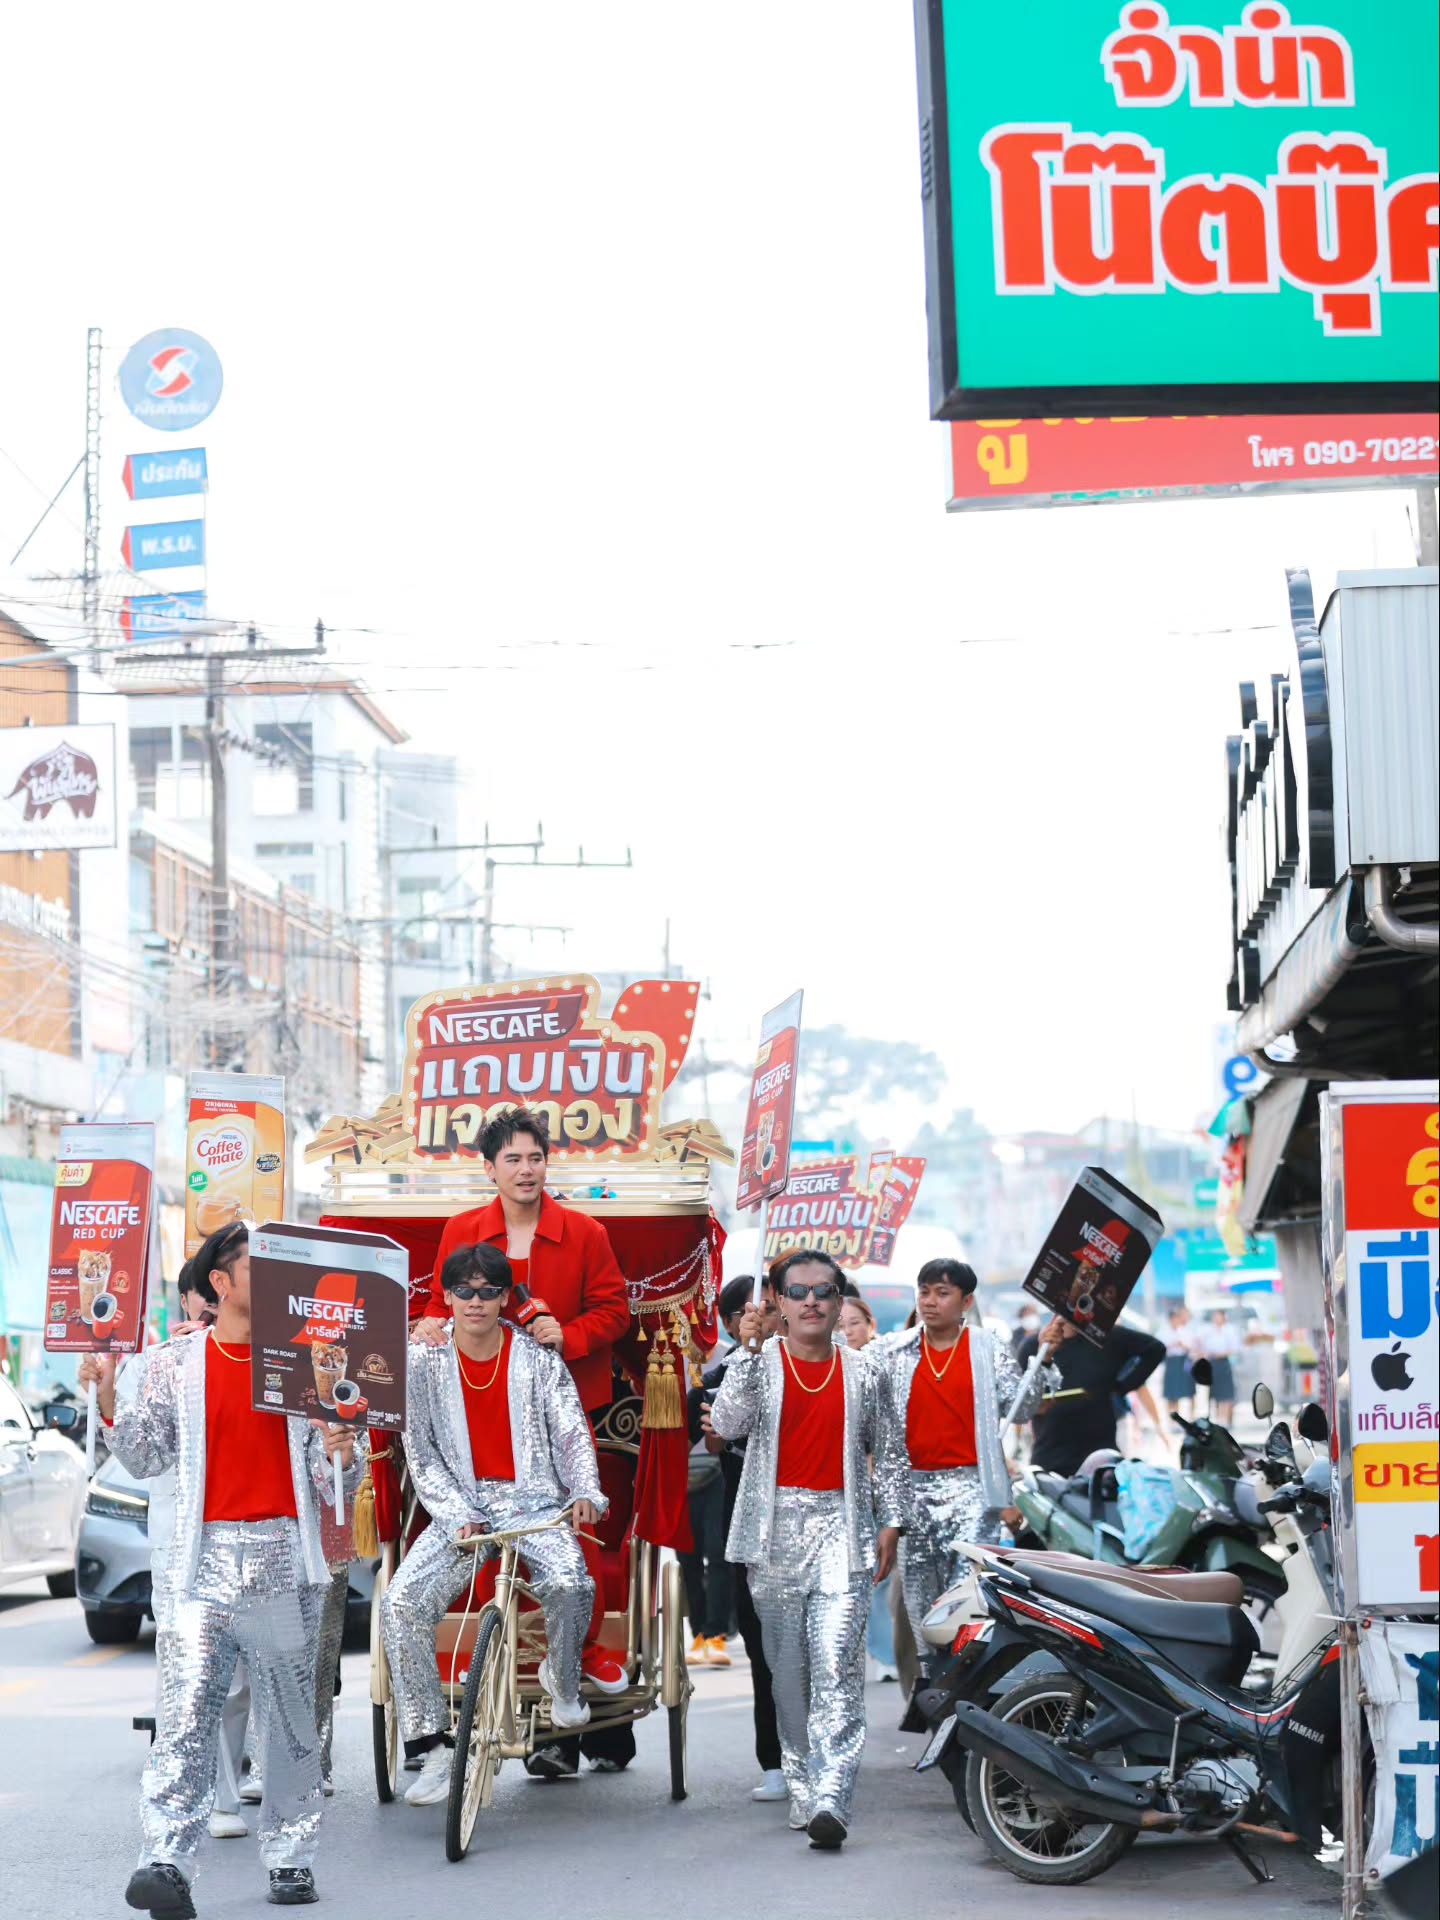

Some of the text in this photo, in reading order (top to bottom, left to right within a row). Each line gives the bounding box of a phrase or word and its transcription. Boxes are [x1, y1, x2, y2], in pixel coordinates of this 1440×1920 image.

[1102, 2, 1354, 106] จำนำ
[1248, 435, 1294, 468] โทร
[1303, 436, 1439, 466] 090-7022
[421, 1039, 645, 1100] แถบเงิน
[196, 1139, 243, 1157] Coffee
[207, 1150, 244, 1167] mate
[769, 1193, 874, 1229] แถบเงิน
[72, 1227, 126, 1239] RED CUP
[263, 1347, 297, 1359] DARK ROAST
[1358, 1403, 1439, 1432] แท็บเล็
[1287, 1718, 1325, 1745] YAMAHA
